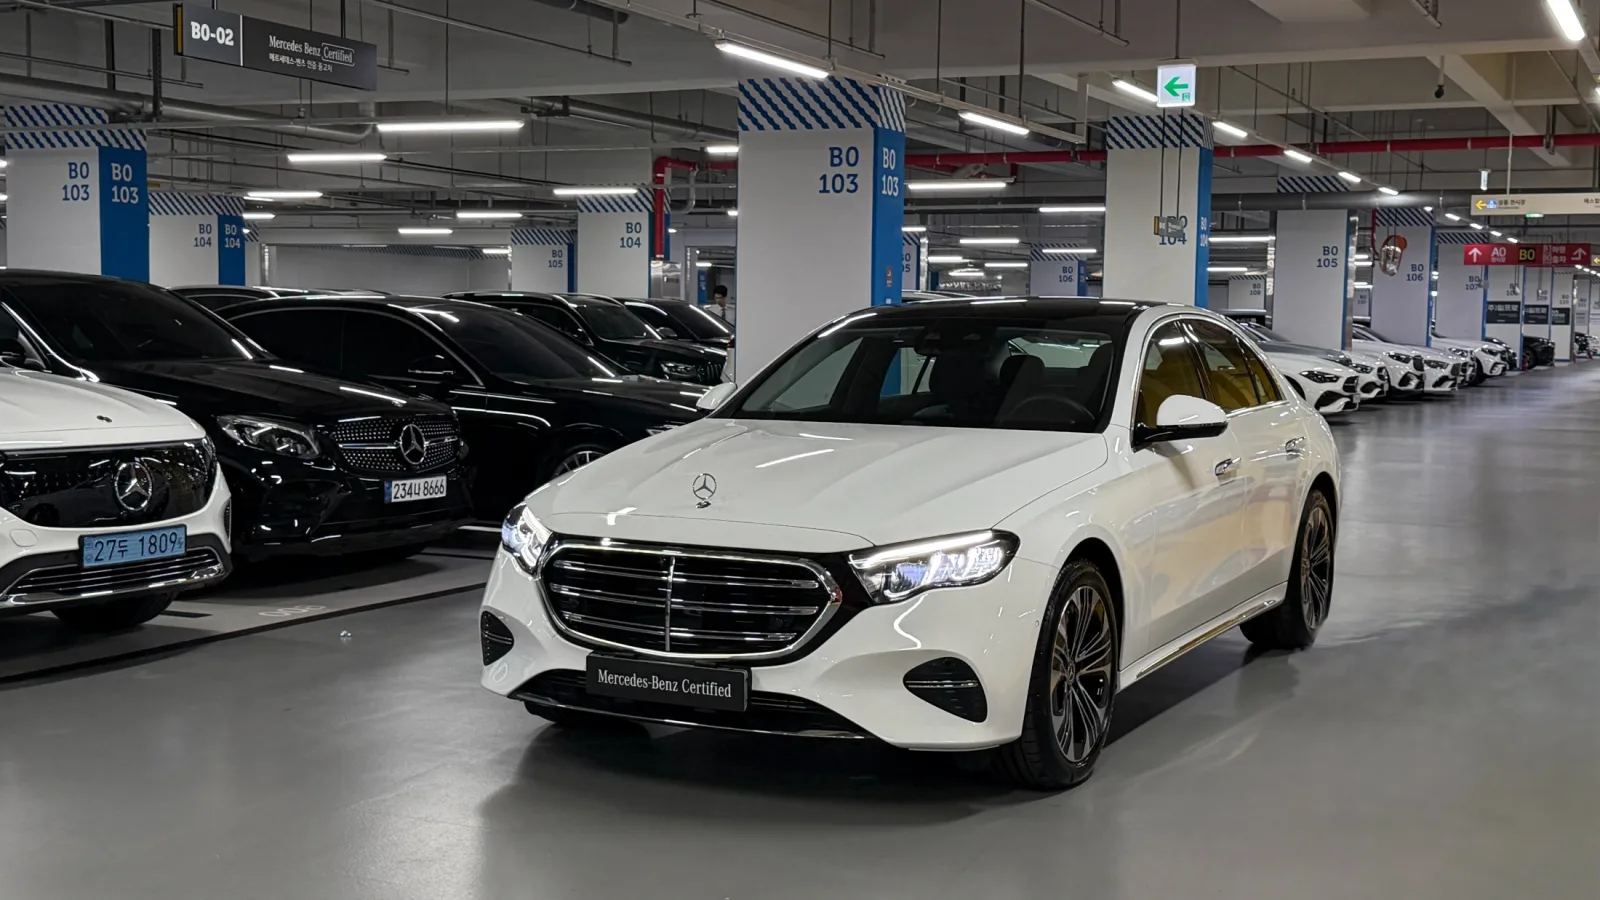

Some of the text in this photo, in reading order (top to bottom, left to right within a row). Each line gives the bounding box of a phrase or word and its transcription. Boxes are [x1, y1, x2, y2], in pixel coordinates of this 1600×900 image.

[190, 21, 234, 46] B0-02
[269, 35, 353, 63] Mercedes Benz Certified
[829, 146, 859, 168] B0
[882, 147, 896, 170] B0
[68, 162, 90, 179] B0
[111, 162, 132, 182] B0
[819, 173, 859, 195] 103
[881, 174, 899, 197] 103
[62, 184, 90, 201] 103
[111, 185, 139, 204] 103
[199, 224, 212, 235] B0
[224, 224, 237, 235] B0
[625, 222, 642, 235] B0
[194, 237, 212, 247] 104
[224, 238, 240, 248] 104
[619, 237, 642, 249] 104
[552, 249, 563, 259] B0
[1322, 246, 1339, 255] B0
[1519, 249, 1535, 260] B0
[548, 260, 563, 268] 105
[1062, 266, 1073, 274] B0
[1316, 258, 1338, 268] 105
[1406, 273, 1424, 281] 106
[393, 479, 445, 499] 234나 8666
[94, 532, 178, 562] 27두 1809
[597, 668, 732, 698] Mercedes-Benz Certified
